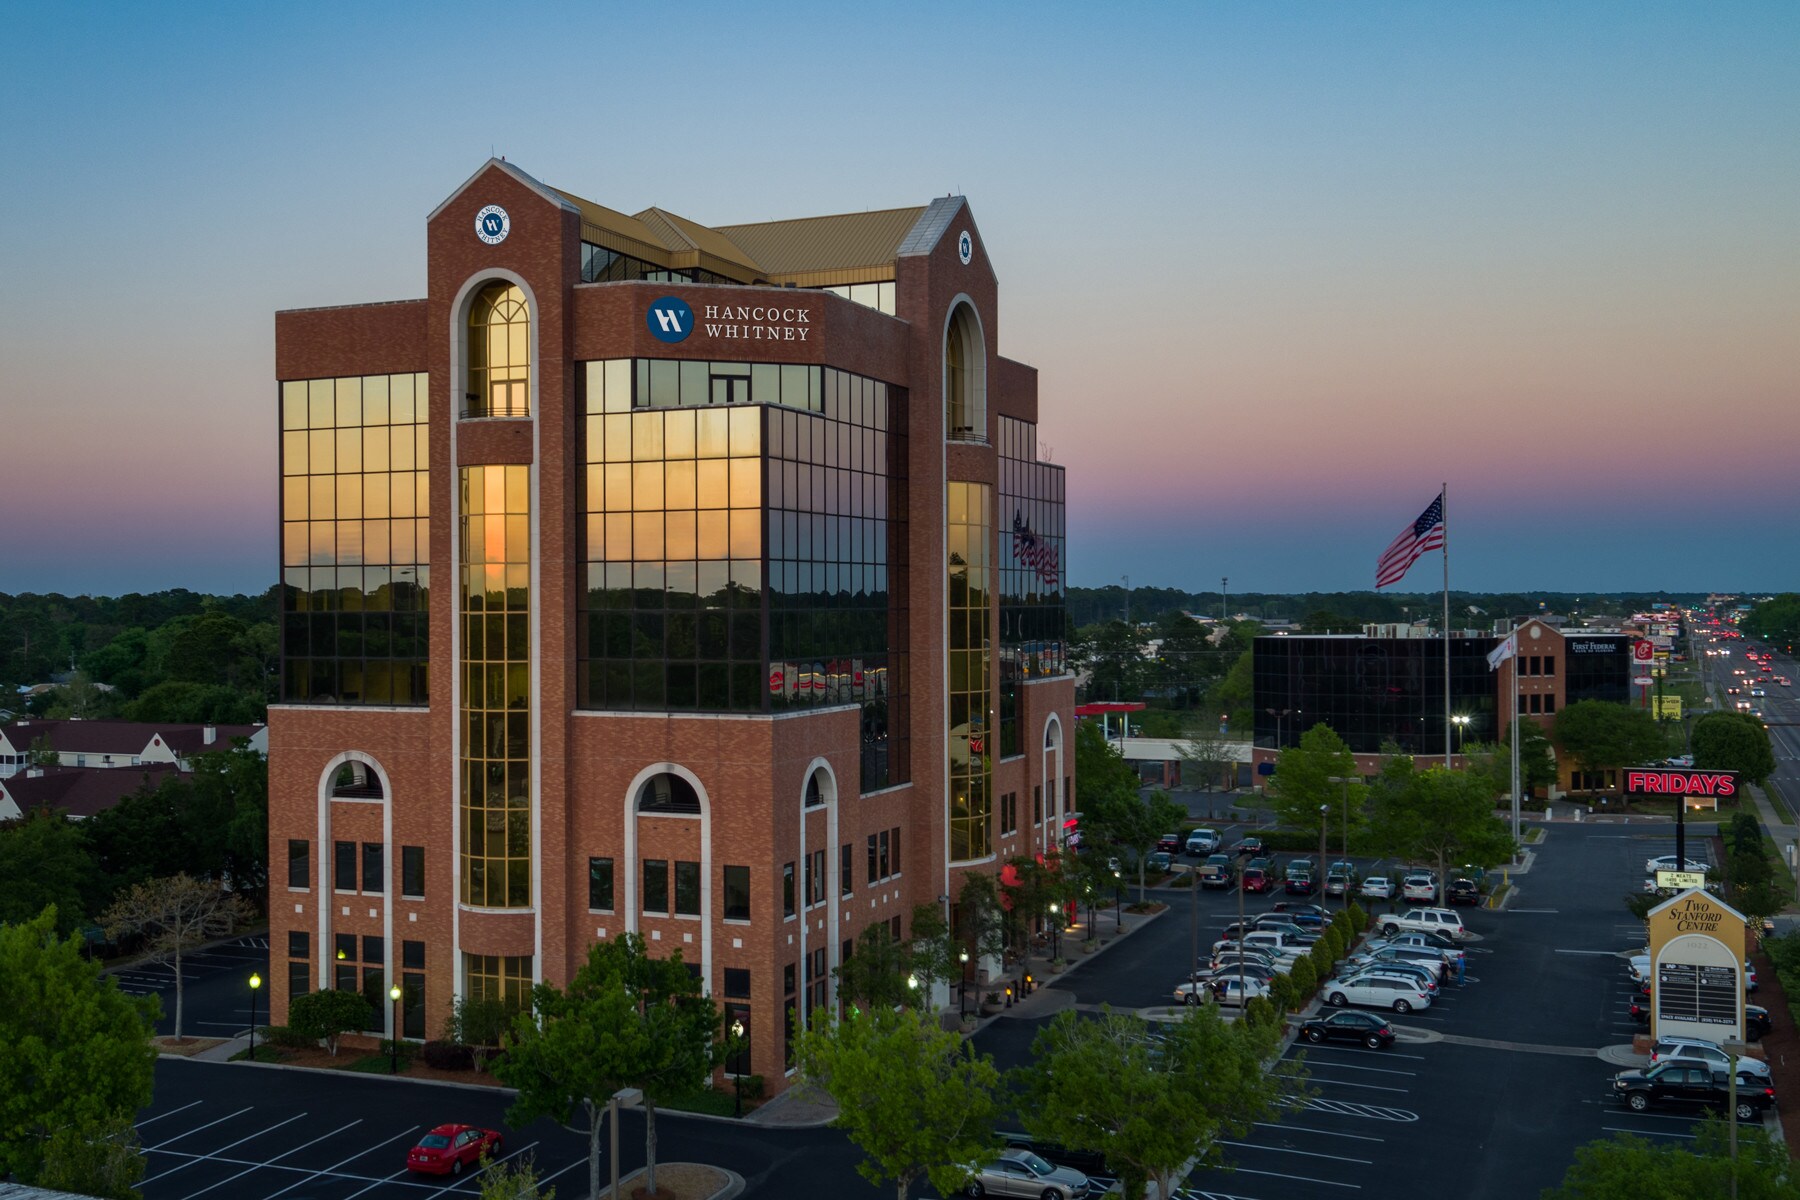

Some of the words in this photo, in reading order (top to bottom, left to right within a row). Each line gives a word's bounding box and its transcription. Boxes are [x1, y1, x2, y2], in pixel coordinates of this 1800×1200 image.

[477, 206, 508, 222] HANCOCK
[477, 227, 508, 244] WHITNEY
[705, 305, 810, 323] HANCOCK
[705, 323, 810, 341] WHITNEY
[1572, 642, 1589, 650] FIRST
[1590, 642, 1616, 650] FEDERAL
[1628, 771, 1735, 796] FRIDAYS
[1685, 900, 1709, 912] TWO
[1669, 908, 1722, 922] STANFORD
[1677, 920, 1719, 932] CENTRE
